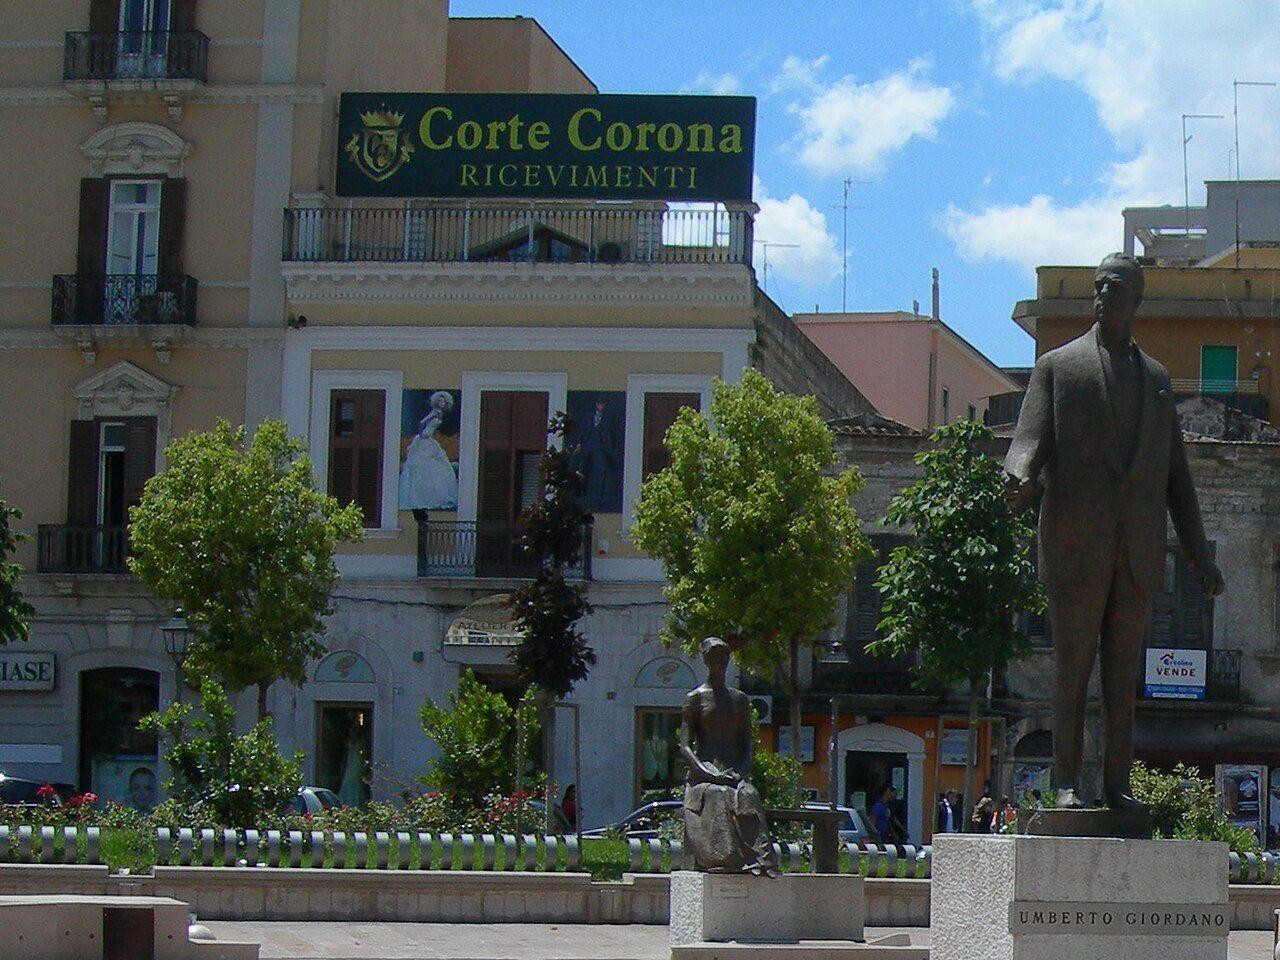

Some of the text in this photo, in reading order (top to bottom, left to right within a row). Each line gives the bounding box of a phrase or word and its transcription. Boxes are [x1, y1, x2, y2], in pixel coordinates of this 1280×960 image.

[418, 106, 743, 154] Corte Corona
[460, 164, 698, 189] RICEVIMENTI
[1156, 668, 1197, 677] VENDE
[1019, 911, 1225, 926] UMBERTO GIORDANO
